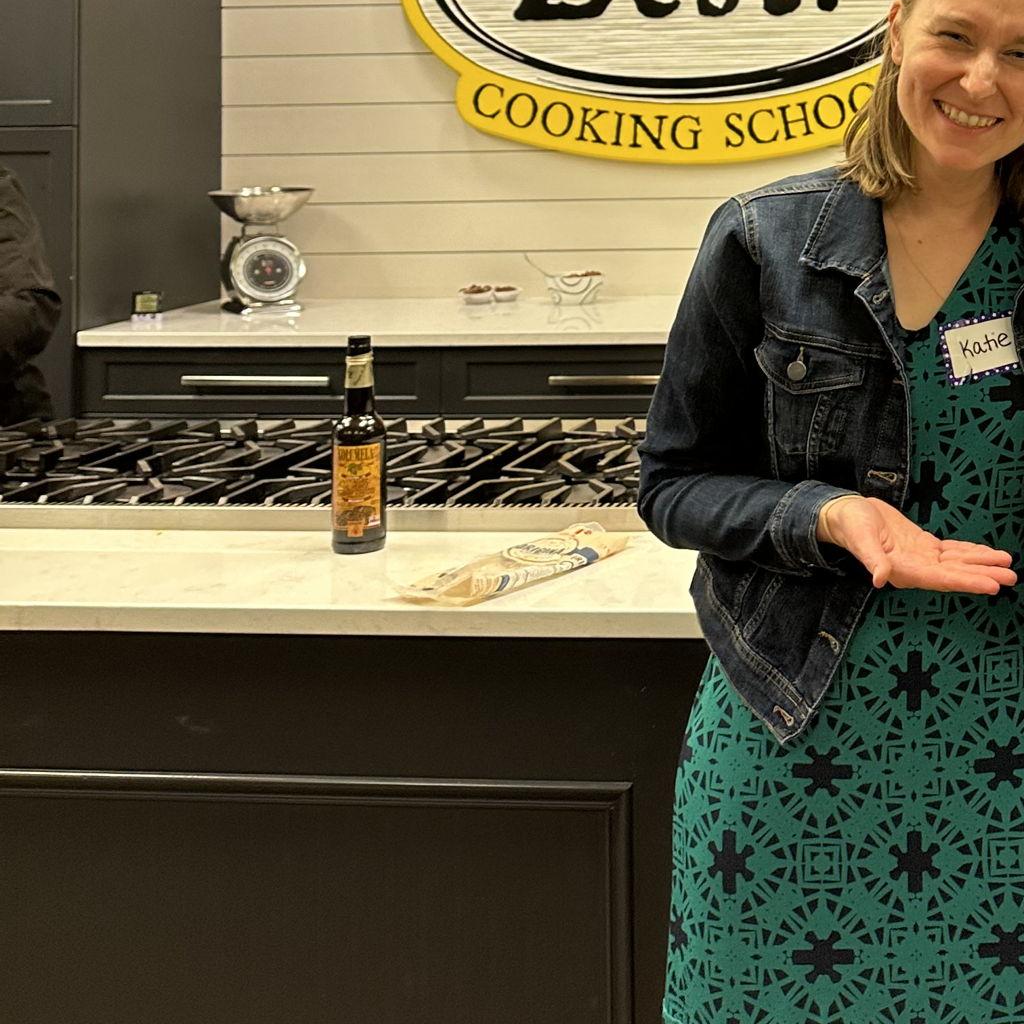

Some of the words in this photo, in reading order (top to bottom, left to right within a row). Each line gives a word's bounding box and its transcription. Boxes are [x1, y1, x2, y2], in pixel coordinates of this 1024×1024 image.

[472, 82, 702, 150] COOKING
[724, 82, 876, 147] SCHOO
[959, 332, 1012, 359] Katie
